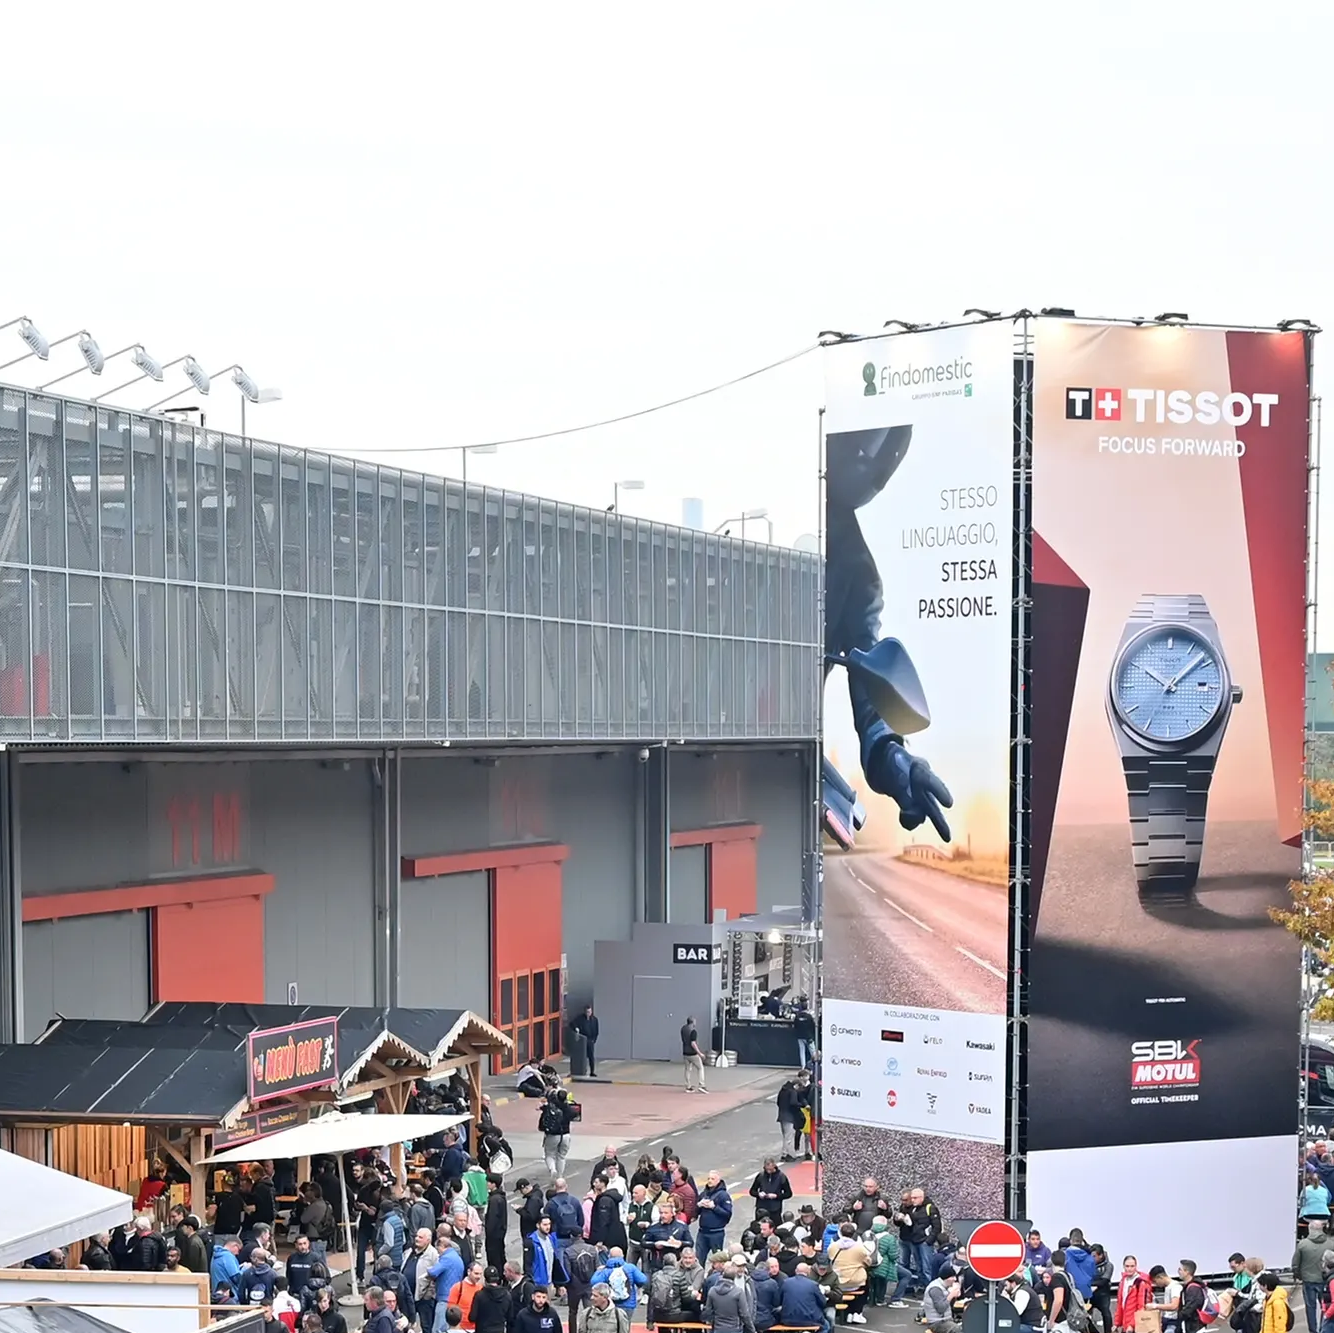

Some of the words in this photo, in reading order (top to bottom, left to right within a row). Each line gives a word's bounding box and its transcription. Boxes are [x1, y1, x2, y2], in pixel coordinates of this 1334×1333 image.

[880, 356, 973, 389] findomestic
[1128, 389, 1279, 427] TISSOT
[1098, 436, 1156, 456] FOCUS
[1161, 438, 1247, 458] FORWARD
[940, 485, 998, 511] STESSO
[901, 522, 999, 550] LINGUAGGIO,
[941, 559, 998, 582] STESSA
[918, 595, 998, 619] PASSIONE.
[677, 946, 709, 961] BAR
[966, 1040, 996, 1051] Kawasaki
[1131, 1039, 1200, 1062] SBK
[1134, 1062, 1196, 1083] MOTUL
[837, 1089, 861, 1098] SUZUKI
[1131, 1096, 1160, 1105] OFFICIAL
[1161, 1094, 1199, 1104] TIMEKEEPER
